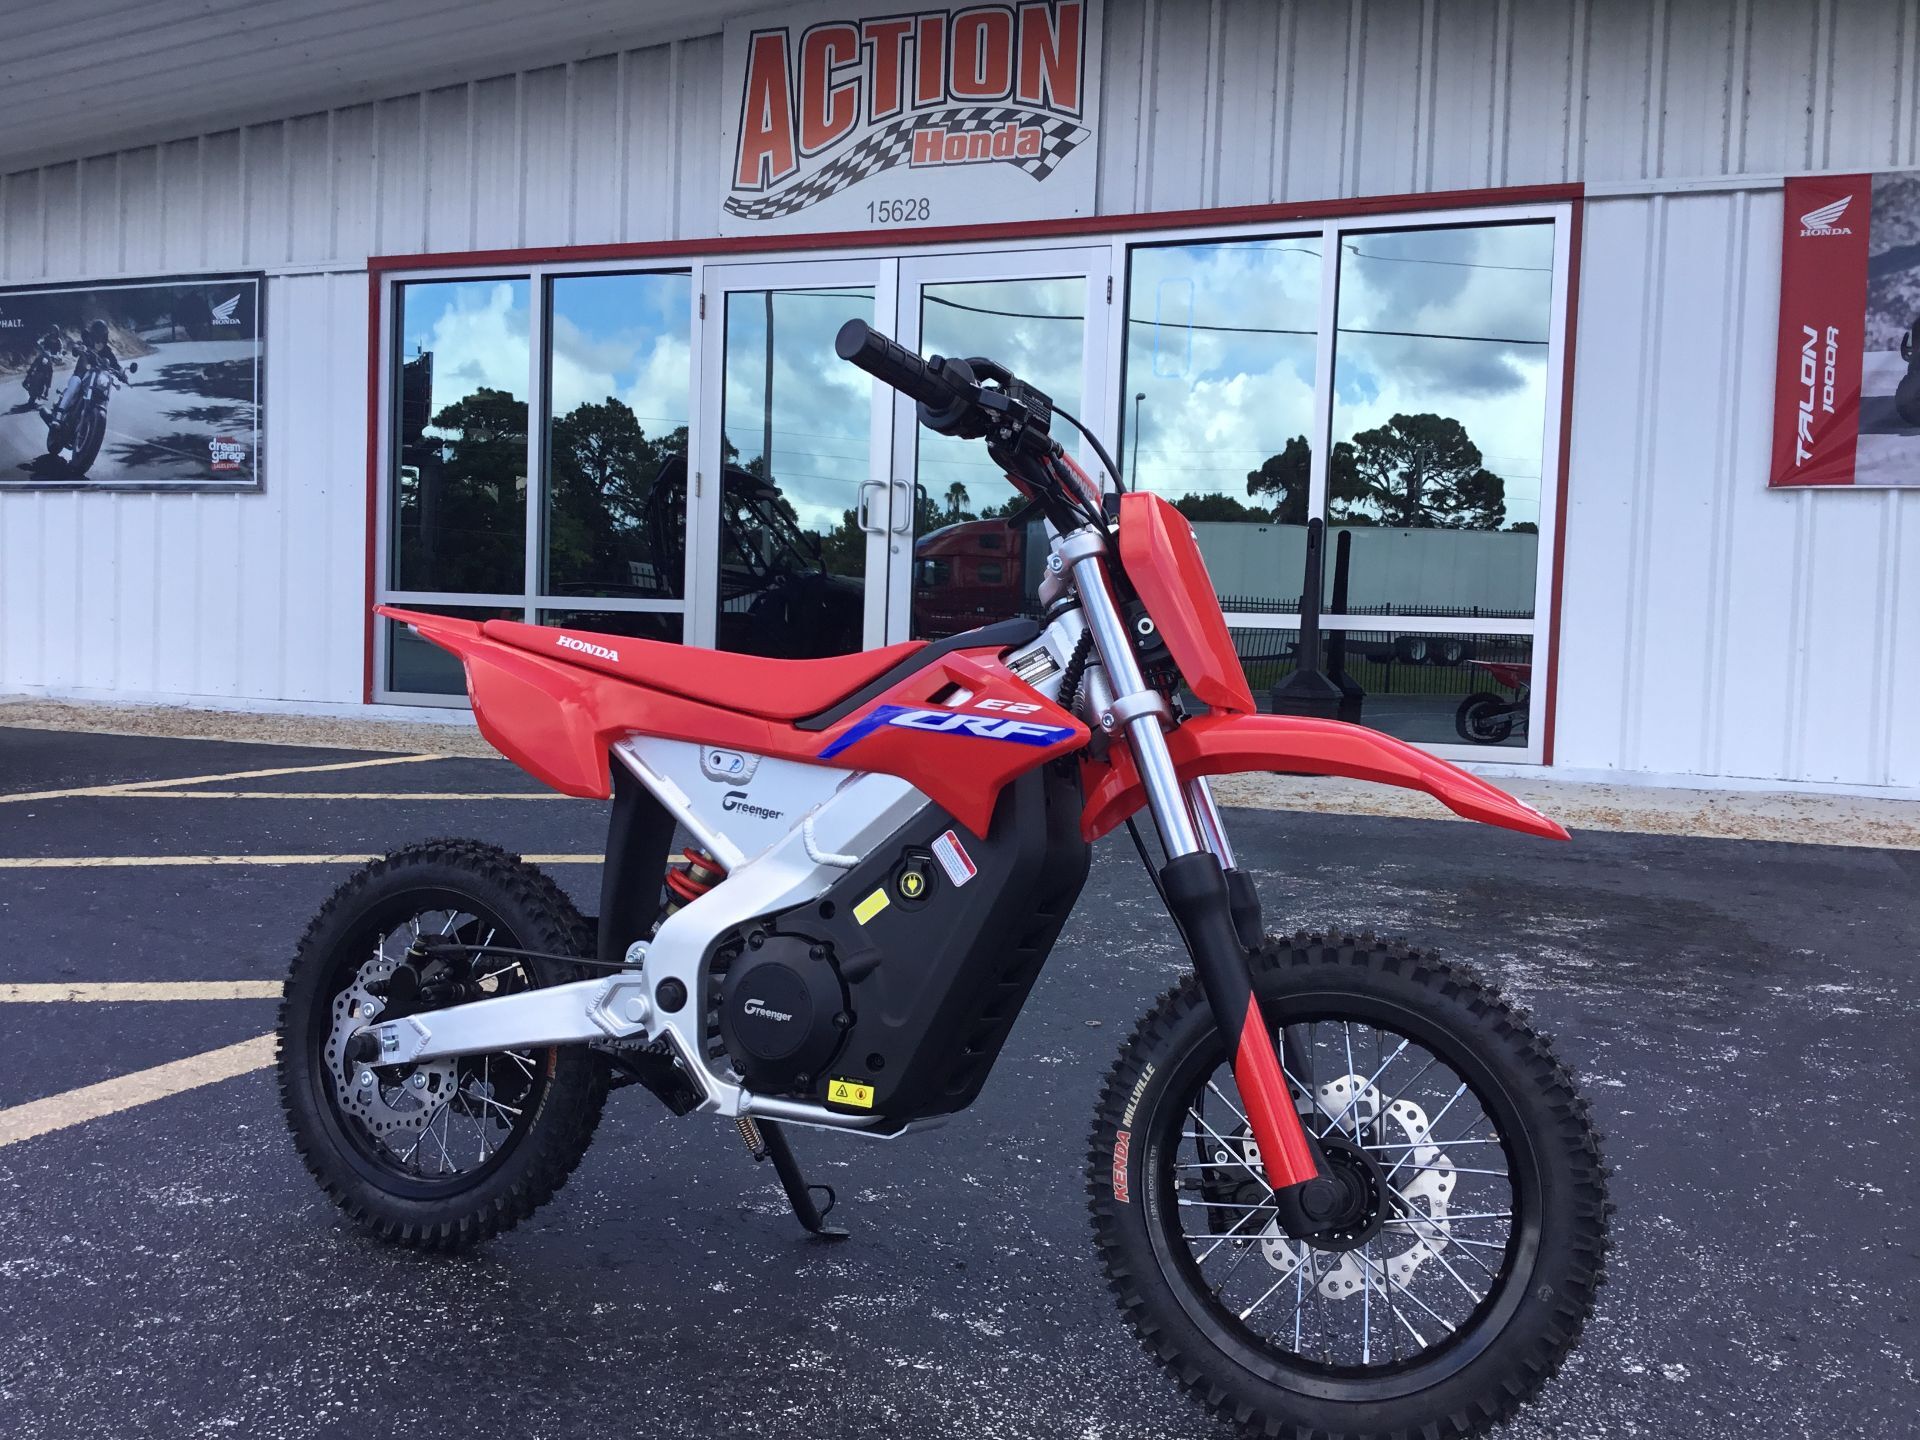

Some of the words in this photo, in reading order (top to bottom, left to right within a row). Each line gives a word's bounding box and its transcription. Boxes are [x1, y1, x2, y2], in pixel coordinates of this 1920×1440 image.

[733, 1, 1085, 190] ACTION
[910, 121, 1044, 168] Honda
[867, 198, 930, 223] 15628
[1800, 227, 1852, 236] HONDA
[212, 318, 241, 326] HONDA
[1822, 326, 1840, 414] 1000R
[1795, 324, 1819, 467] TALON
[208, 437, 241, 451] dream
[211, 450, 246, 464] garage
[556, 634, 619, 662] HONDA
[974, 698, 1042, 714] E2
[889, 711, 1066, 739] CRF
[722, 791, 781, 819] Greenger
[744, 998, 793, 1022] Greenger
[1112, 1129, 1132, 1204] KENDA
[1122, 1062, 1156, 1128] MILLVILLE
